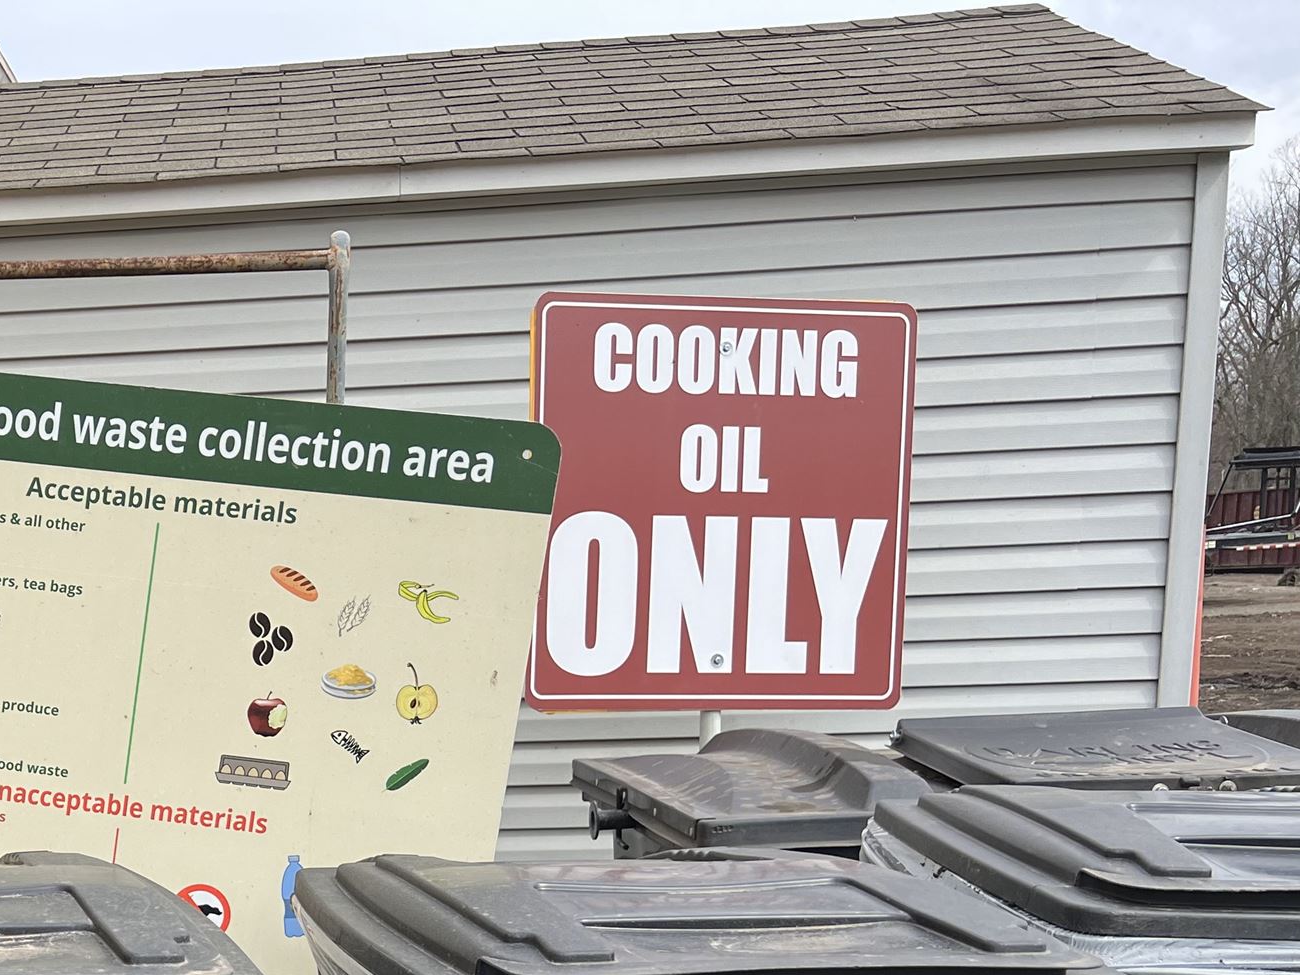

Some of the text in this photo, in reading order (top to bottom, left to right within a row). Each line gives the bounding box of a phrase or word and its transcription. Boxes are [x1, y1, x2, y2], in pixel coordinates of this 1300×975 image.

[594, 322, 859, 398] COOKING
[73, 413, 187, 454] waste
[199, 420, 392, 474] collection
[402, 444, 494, 483] area
[679, 423, 768, 493] OIL
[26, 477, 298, 524] Acceptable materials
[10, 512, 21, 524] &
[24, 512, 42, 528] all
[45, 516, 86, 532] other
[23, 579, 47, 591] tea
[50, 580, 83, 596] bags
[546, 510, 889, 677] ONLY
[2, 699, 59, 717] produce
[26, 761, 69, 778] waste
[150, 801, 268, 834] materials
